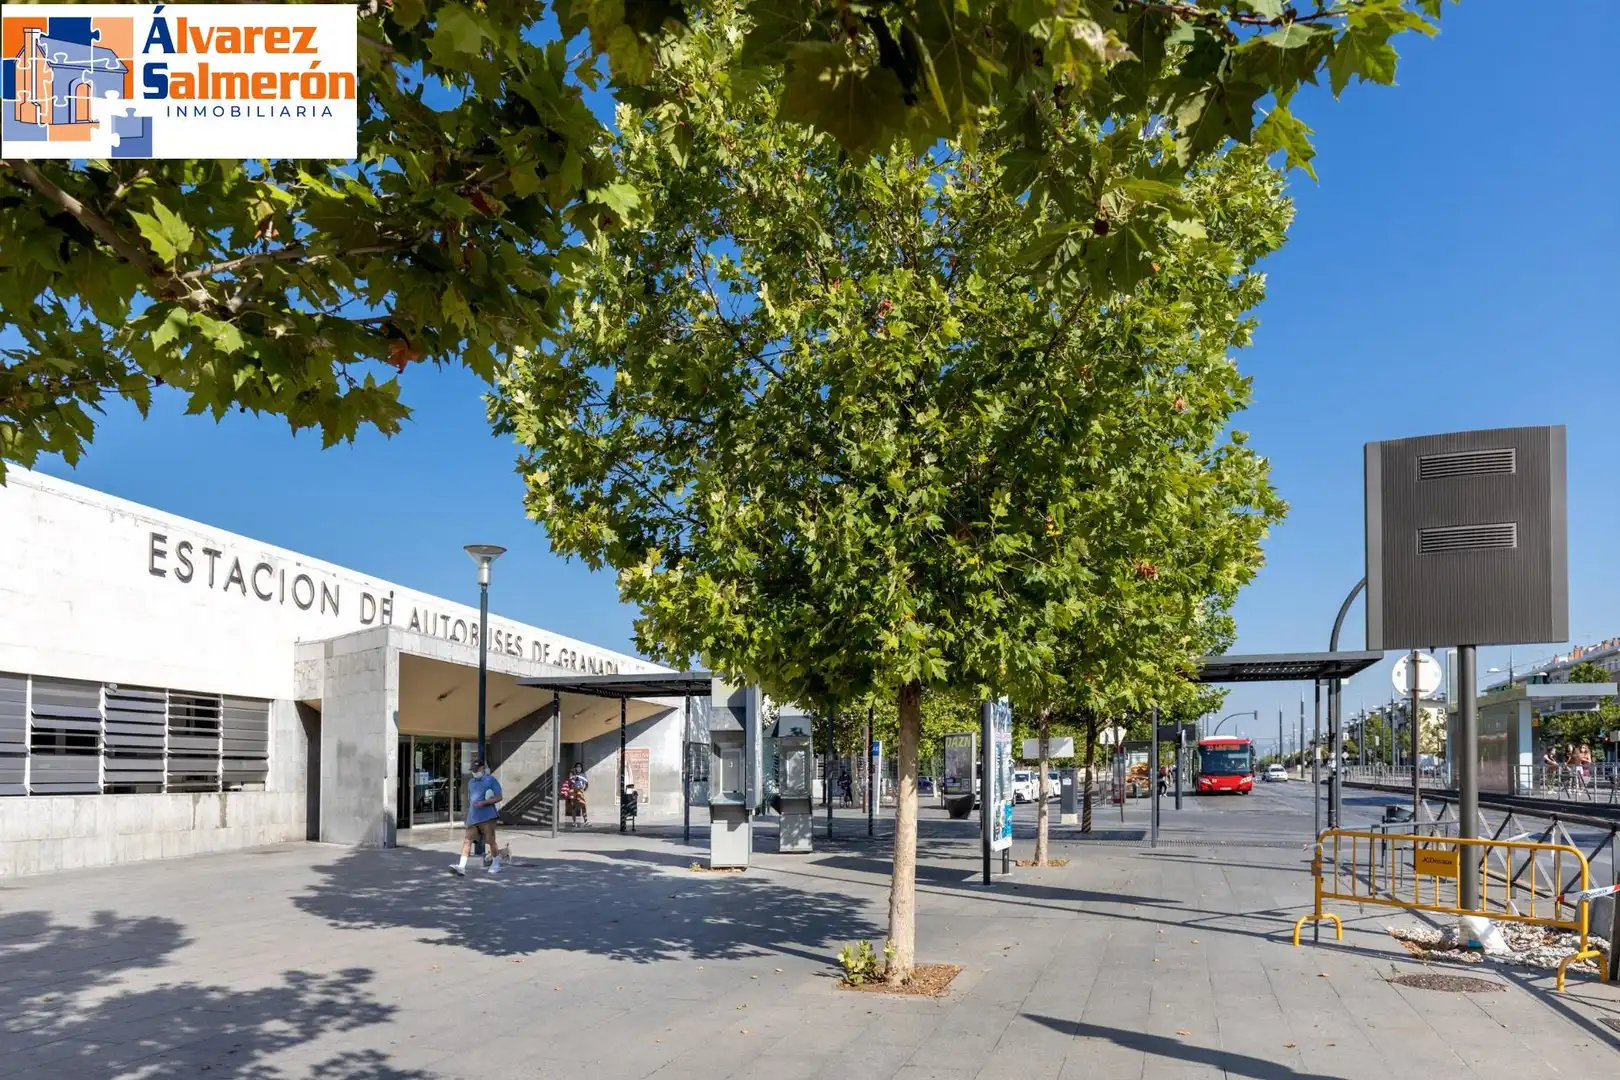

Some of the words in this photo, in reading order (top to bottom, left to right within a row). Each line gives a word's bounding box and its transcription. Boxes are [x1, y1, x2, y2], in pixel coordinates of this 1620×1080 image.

[148, 531, 340, 617] ESTACION
[945, 735, 971, 749] DAZN
[1421, 856, 1453, 865] JCDecaux
